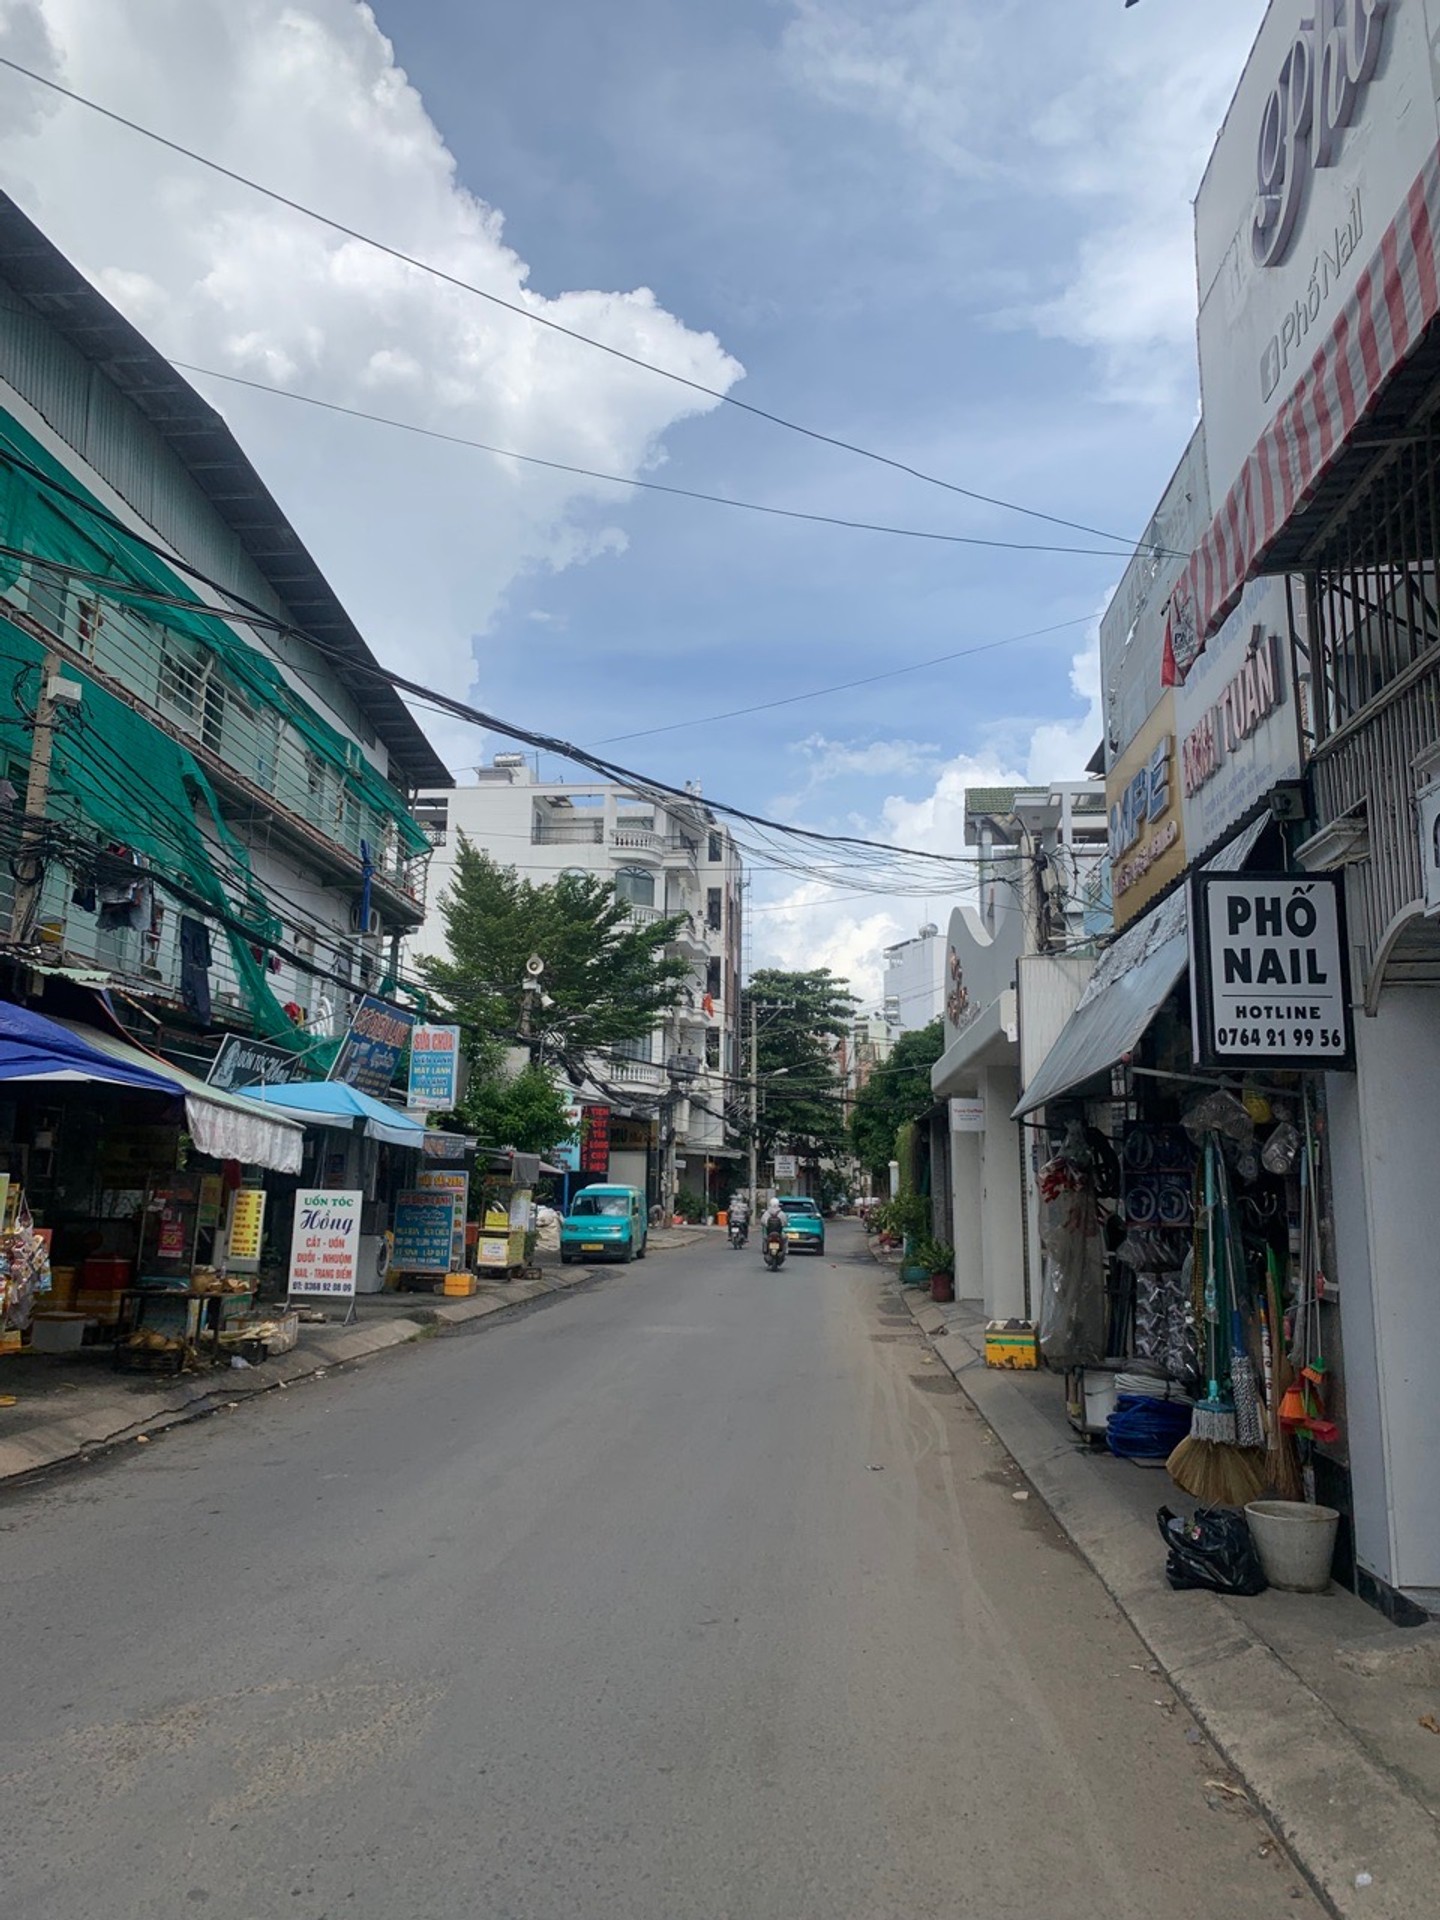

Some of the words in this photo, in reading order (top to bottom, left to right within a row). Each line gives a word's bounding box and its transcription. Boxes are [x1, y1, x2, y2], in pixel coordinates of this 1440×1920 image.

[1323, 186, 1364, 300] Nail
[1227, 884, 1317, 938] PHỐ
[1223, 948, 1328, 984] NAIL
[1235, 1005, 1321, 1019] HOTLINE
[1218, 1027, 1261, 1047] 0764
[1266, 1028, 1286, 1047] 21
[1293, 1028, 1314, 1047] 99
[1320, 1029, 1341, 1048] 56
[304, 1194, 328, 1206] UỐN
[331, 1196, 354, 1207] TÓC
[300, 1209, 354, 1236] Hồng
